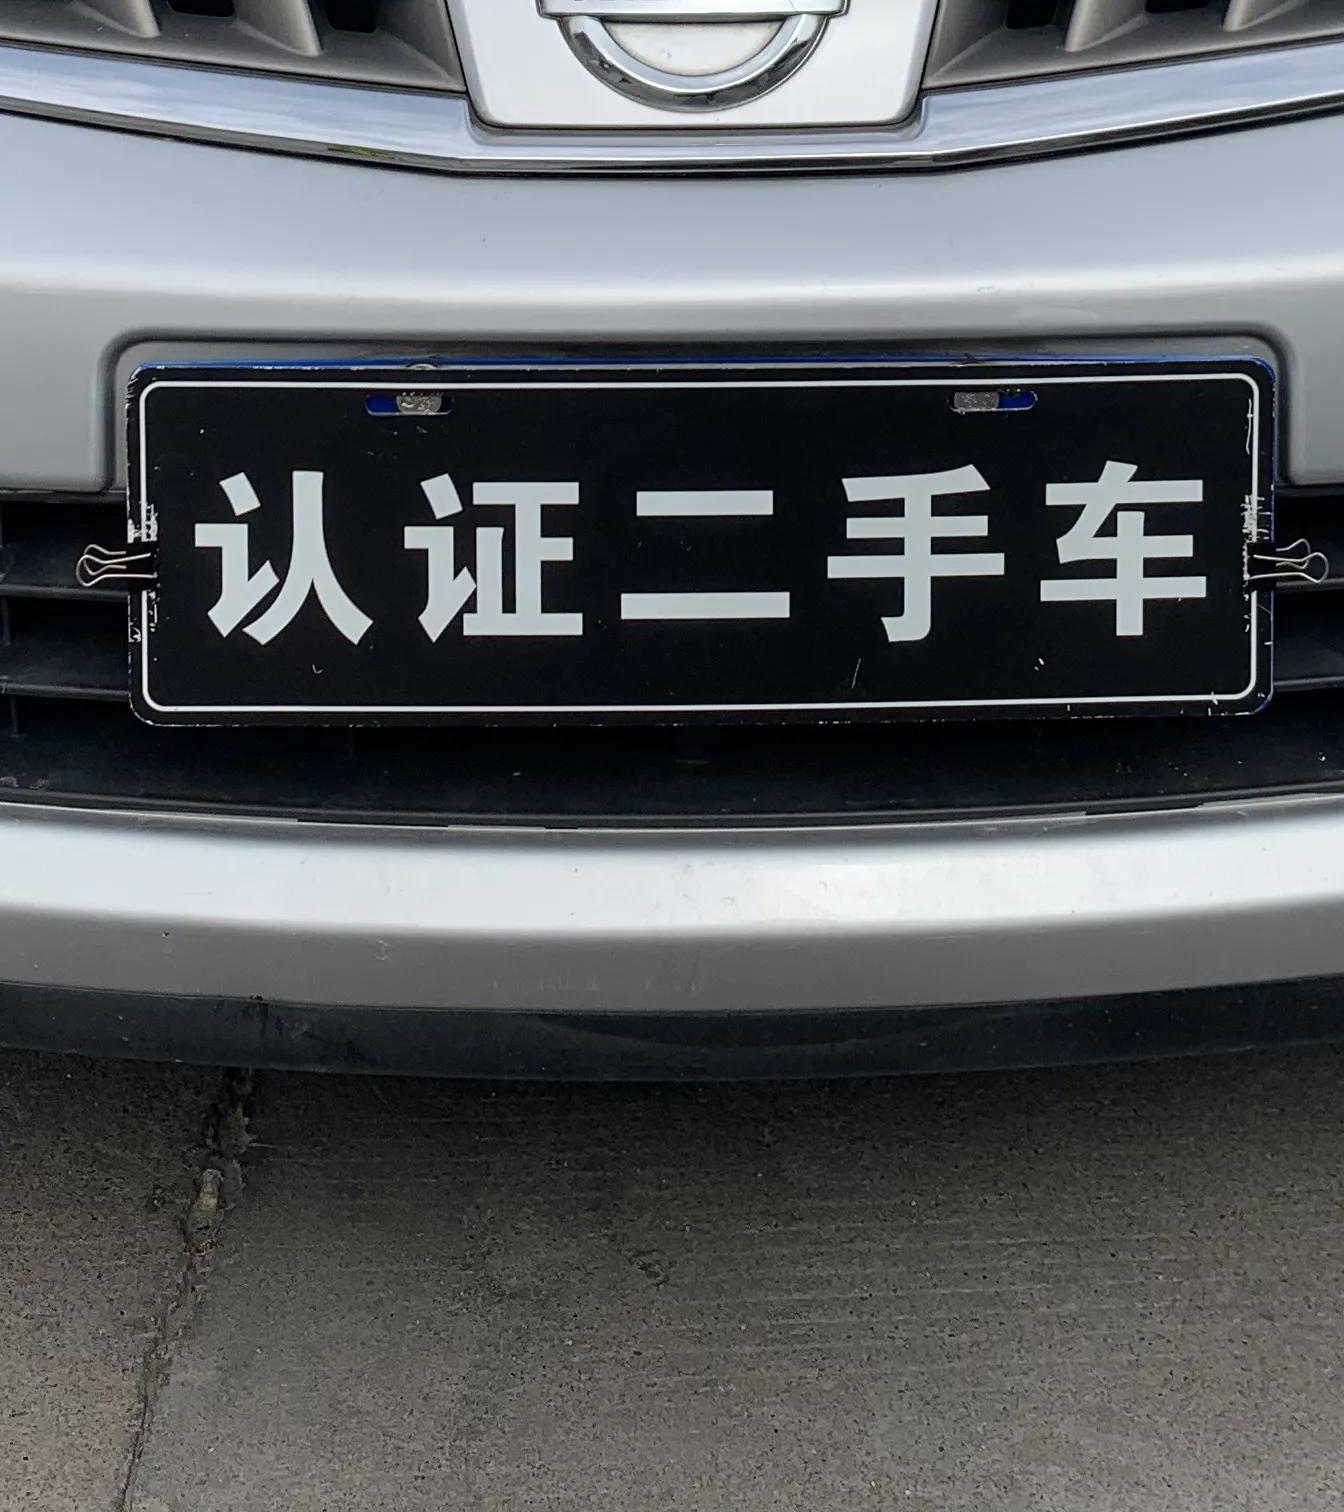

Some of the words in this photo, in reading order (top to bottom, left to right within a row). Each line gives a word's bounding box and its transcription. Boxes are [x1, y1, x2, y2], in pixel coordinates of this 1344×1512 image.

[194, 461, 1208, 645] 认证二手车
